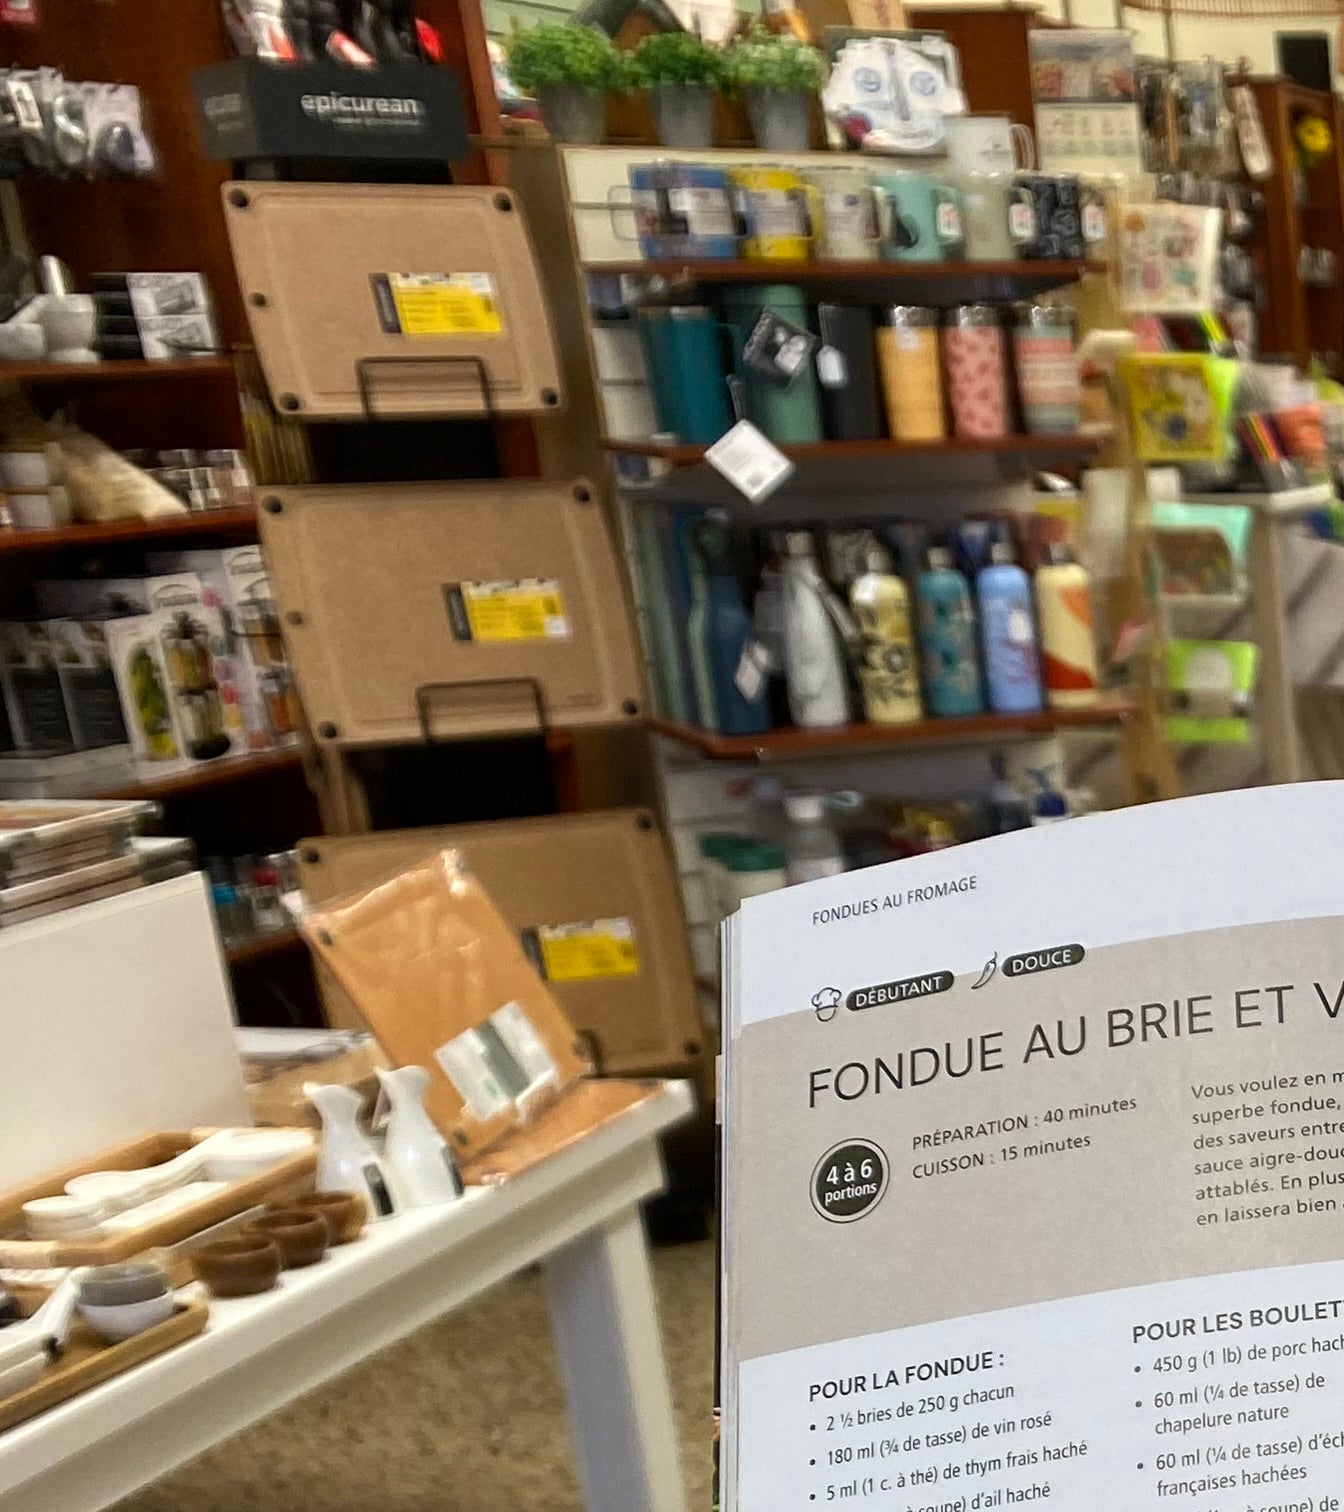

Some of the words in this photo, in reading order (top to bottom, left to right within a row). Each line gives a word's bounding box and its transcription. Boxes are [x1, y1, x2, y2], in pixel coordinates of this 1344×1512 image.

[301, 92, 420, 120] epicurean
[812, 898, 879, 926] FONDUES
[882, 893, 903, 910] AU
[907, 875, 977, 905] FROMAGE
[1012, 949, 1072, 973] DOUCE
[855, 975, 943, 1008] DÉBUTANT
[809, 1031, 1004, 1109] FONDUE
[1022, 1015, 1086, 1064] AU
[1107, 994, 1214, 1048] BRIE
[1234, 984, 1295, 1029] ET
[912, 1114, 1028, 1151] PRÉPARATION
[1043, 1108, 1064, 1124] 40
[1068, 1098, 1137, 1121] minutes
[826, 1165, 838, 1185] 4
[844, 1162, 855, 1181] à
[860, 1158, 873, 1178] 6
[912, 1152, 984, 1179] CUISSON
[1000, 1145, 1018, 1162] 15
[1023, 1135, 1091, 1158] minutes
[824, 1181, 877, 1206] portions
[1196, 1213, 1219, 1226] en
[1224, 1204, 1291, 1223] laissera
[1296, 1198, 1337, 1214] bien
[1132, 1318, 1196, 1344] POUR
[1202, 1311, 1243, 1334] LES
[809, 1375, 867, 1403] POUR
[872, 1369, 900, 1390] LA
[905, 1351, 994, 1384] FONDUE
[826, 1415, 835, 1432] 2
[857, 1408, 893, 1425] bries
[896, 1401, 914, 1418] de
[918, 1395, 945, 1415] 250
[949, 1396, 959, 1413] g
[962, 1386, 1015, 1406] chacun
[1154, 1412, 1233, 1436] chapelure
[1237, 1406, 1290, 1424] nature
[1156, 1474, 1237, 1497] françaises
[1241, 1464, 1308, 1486] hachées
